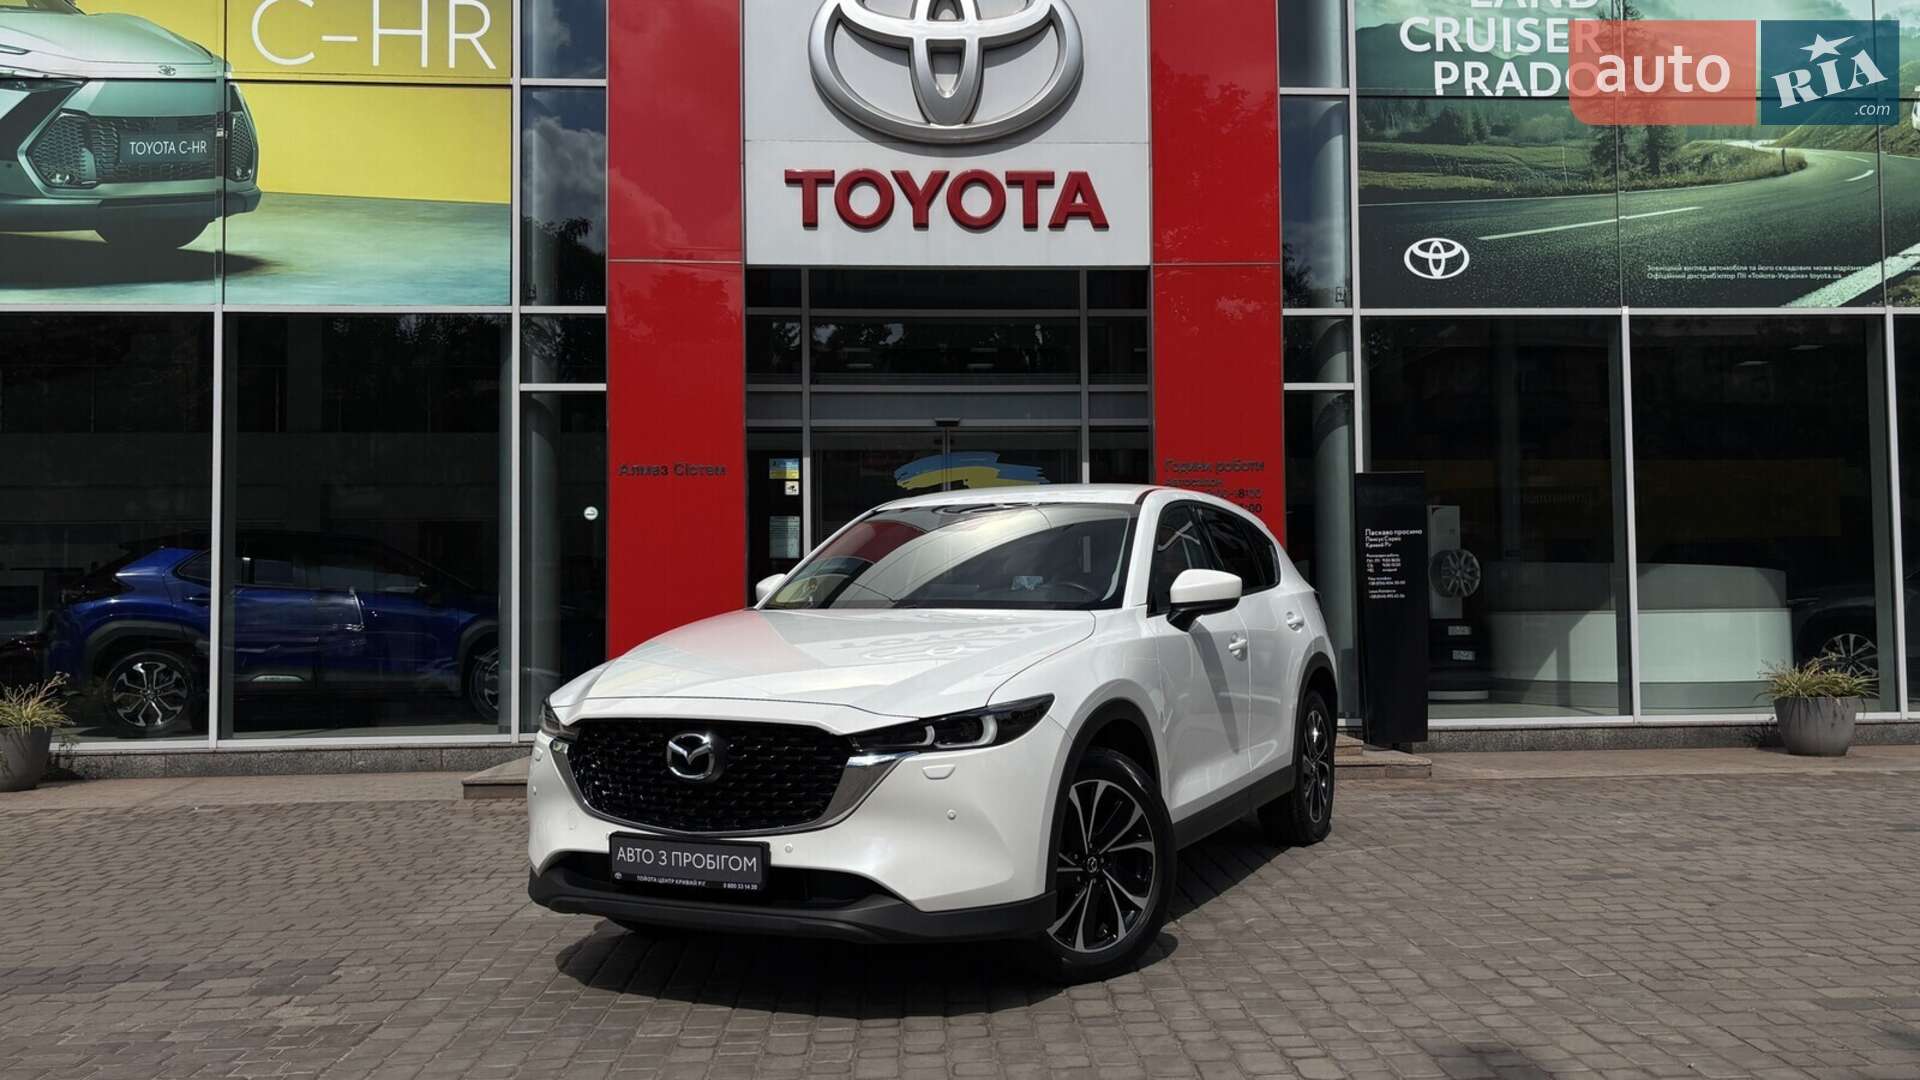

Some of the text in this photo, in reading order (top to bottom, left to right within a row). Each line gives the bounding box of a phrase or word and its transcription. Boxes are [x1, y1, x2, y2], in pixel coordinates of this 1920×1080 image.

[252, 0, 497, 69] C-HR
[1400, 16, 1603, 53] CRUISER
[128, 140, 207, 155] TOYOTA C-HR
[785, 168, 1109, 231] TOYOTA
[617, 846, 654, 864] АВТО
[671, 851, 757, 872] ПРОБІГОМ
